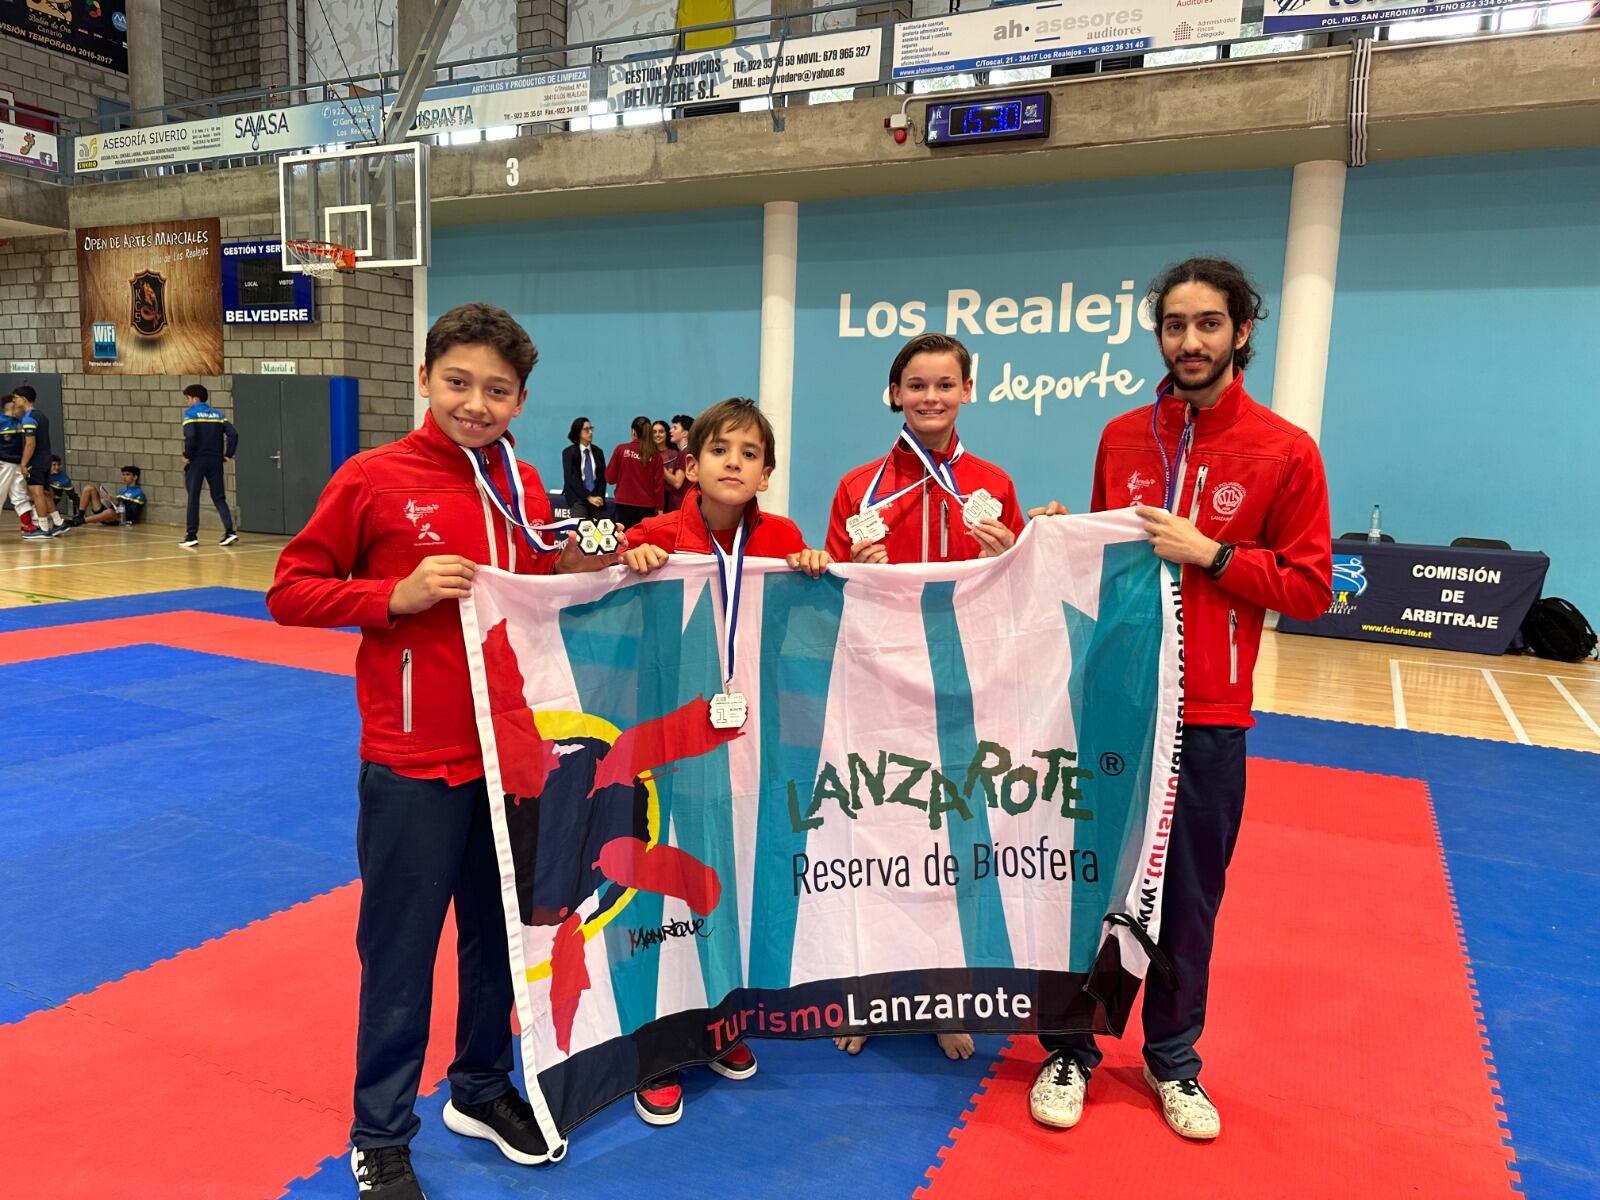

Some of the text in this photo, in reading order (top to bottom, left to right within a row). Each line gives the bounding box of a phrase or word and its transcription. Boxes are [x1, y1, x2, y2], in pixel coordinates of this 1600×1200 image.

[1380, 7, 1426, 18] JERÓNIMO
[1435, 4, 1458, 12] TFNO
[1460, 1, 1476, 9] 922
[1035, 8, 1143, 34] asesores
[28, 32, 77, 53] TEMPORADA
[1087, 25, 1142, 40] auditores
[763, 59, 772, 69] 33
[785, 56, 795, 66] 59
[823, 50, 838, 62] 679
[840, 48, 854, 60] 965
[855, 45, 870, 57] 327
[1019, 54, 1038, 63] 38417
[1053, 49, 1082, 59] Realejos
[625, 63, 662, 84] GESTIÓN
[674, 58, 721, 78] SERVICIOS
[732, 67, 845, 89] EMAIL: gsbvedere@yahoo.es
[472, 82, 504, 94] ARTÍCULOS
[511, 77, 545, 88] PRODUCTOS
[557, 72, 586, 82] LIMPIEZA
[697, 79, 720, 100] S.L.
[235, 112, 289, 139] SAVASA
[103, 131, 146, 150] ASESORÍA
[149, 128, 187, 144] SIVERIO
[506, 157, 519, 187] 3
[84, 231, 209, 251] OPEN DE ARTES MARCIALES
[224, 245, 257, 256] GESTIÓN
[186, 246, 208, 259] Realejos
[226, 308, 308, 322] BELVEDERE
[838, 292, 926, 338] Los
[94, 326, 115, 342] WiFi
[262, 364, 288, 372] Material
[988, 352, 1145, 416] deporte
[1412, 564, 1502, 584] COMISIÓN
[1441, 590, 1464, 604] DE
[1401, 608, 1499, 630] ARBITRAJE
[1361, 623, 1432, 640] www.fckarate.net
[716, 708, 727, 723] 1
[787, 740, 1094, 834] LANZAROTE
[792, 835, 1099, 896] Reserva de Biosfera
[707, 986, 1032, 1051] TurismoLanzarote
